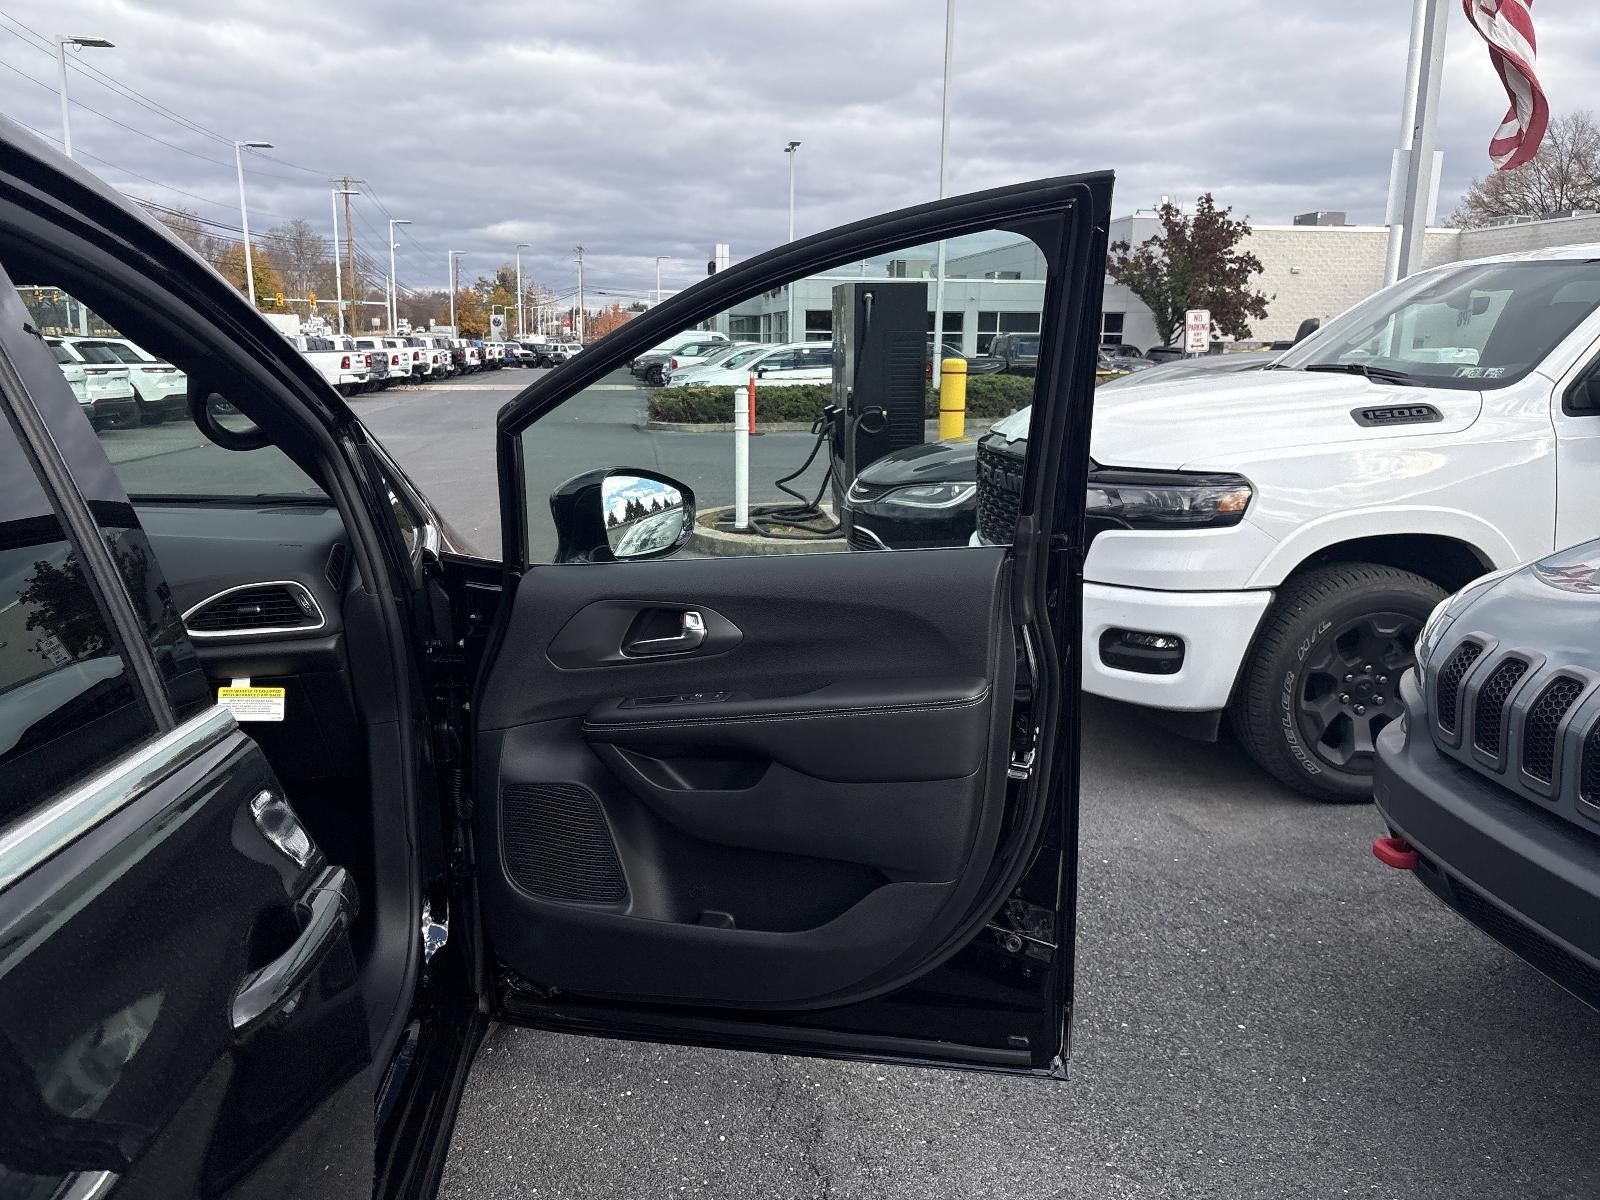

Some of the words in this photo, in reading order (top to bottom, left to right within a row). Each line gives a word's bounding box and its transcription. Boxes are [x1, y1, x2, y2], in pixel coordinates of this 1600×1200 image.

[1194, 314, 1203, 322] NO
[1366, 407, 1428, 420] 1500
[1282, 671, 1320, 774] DUELER
